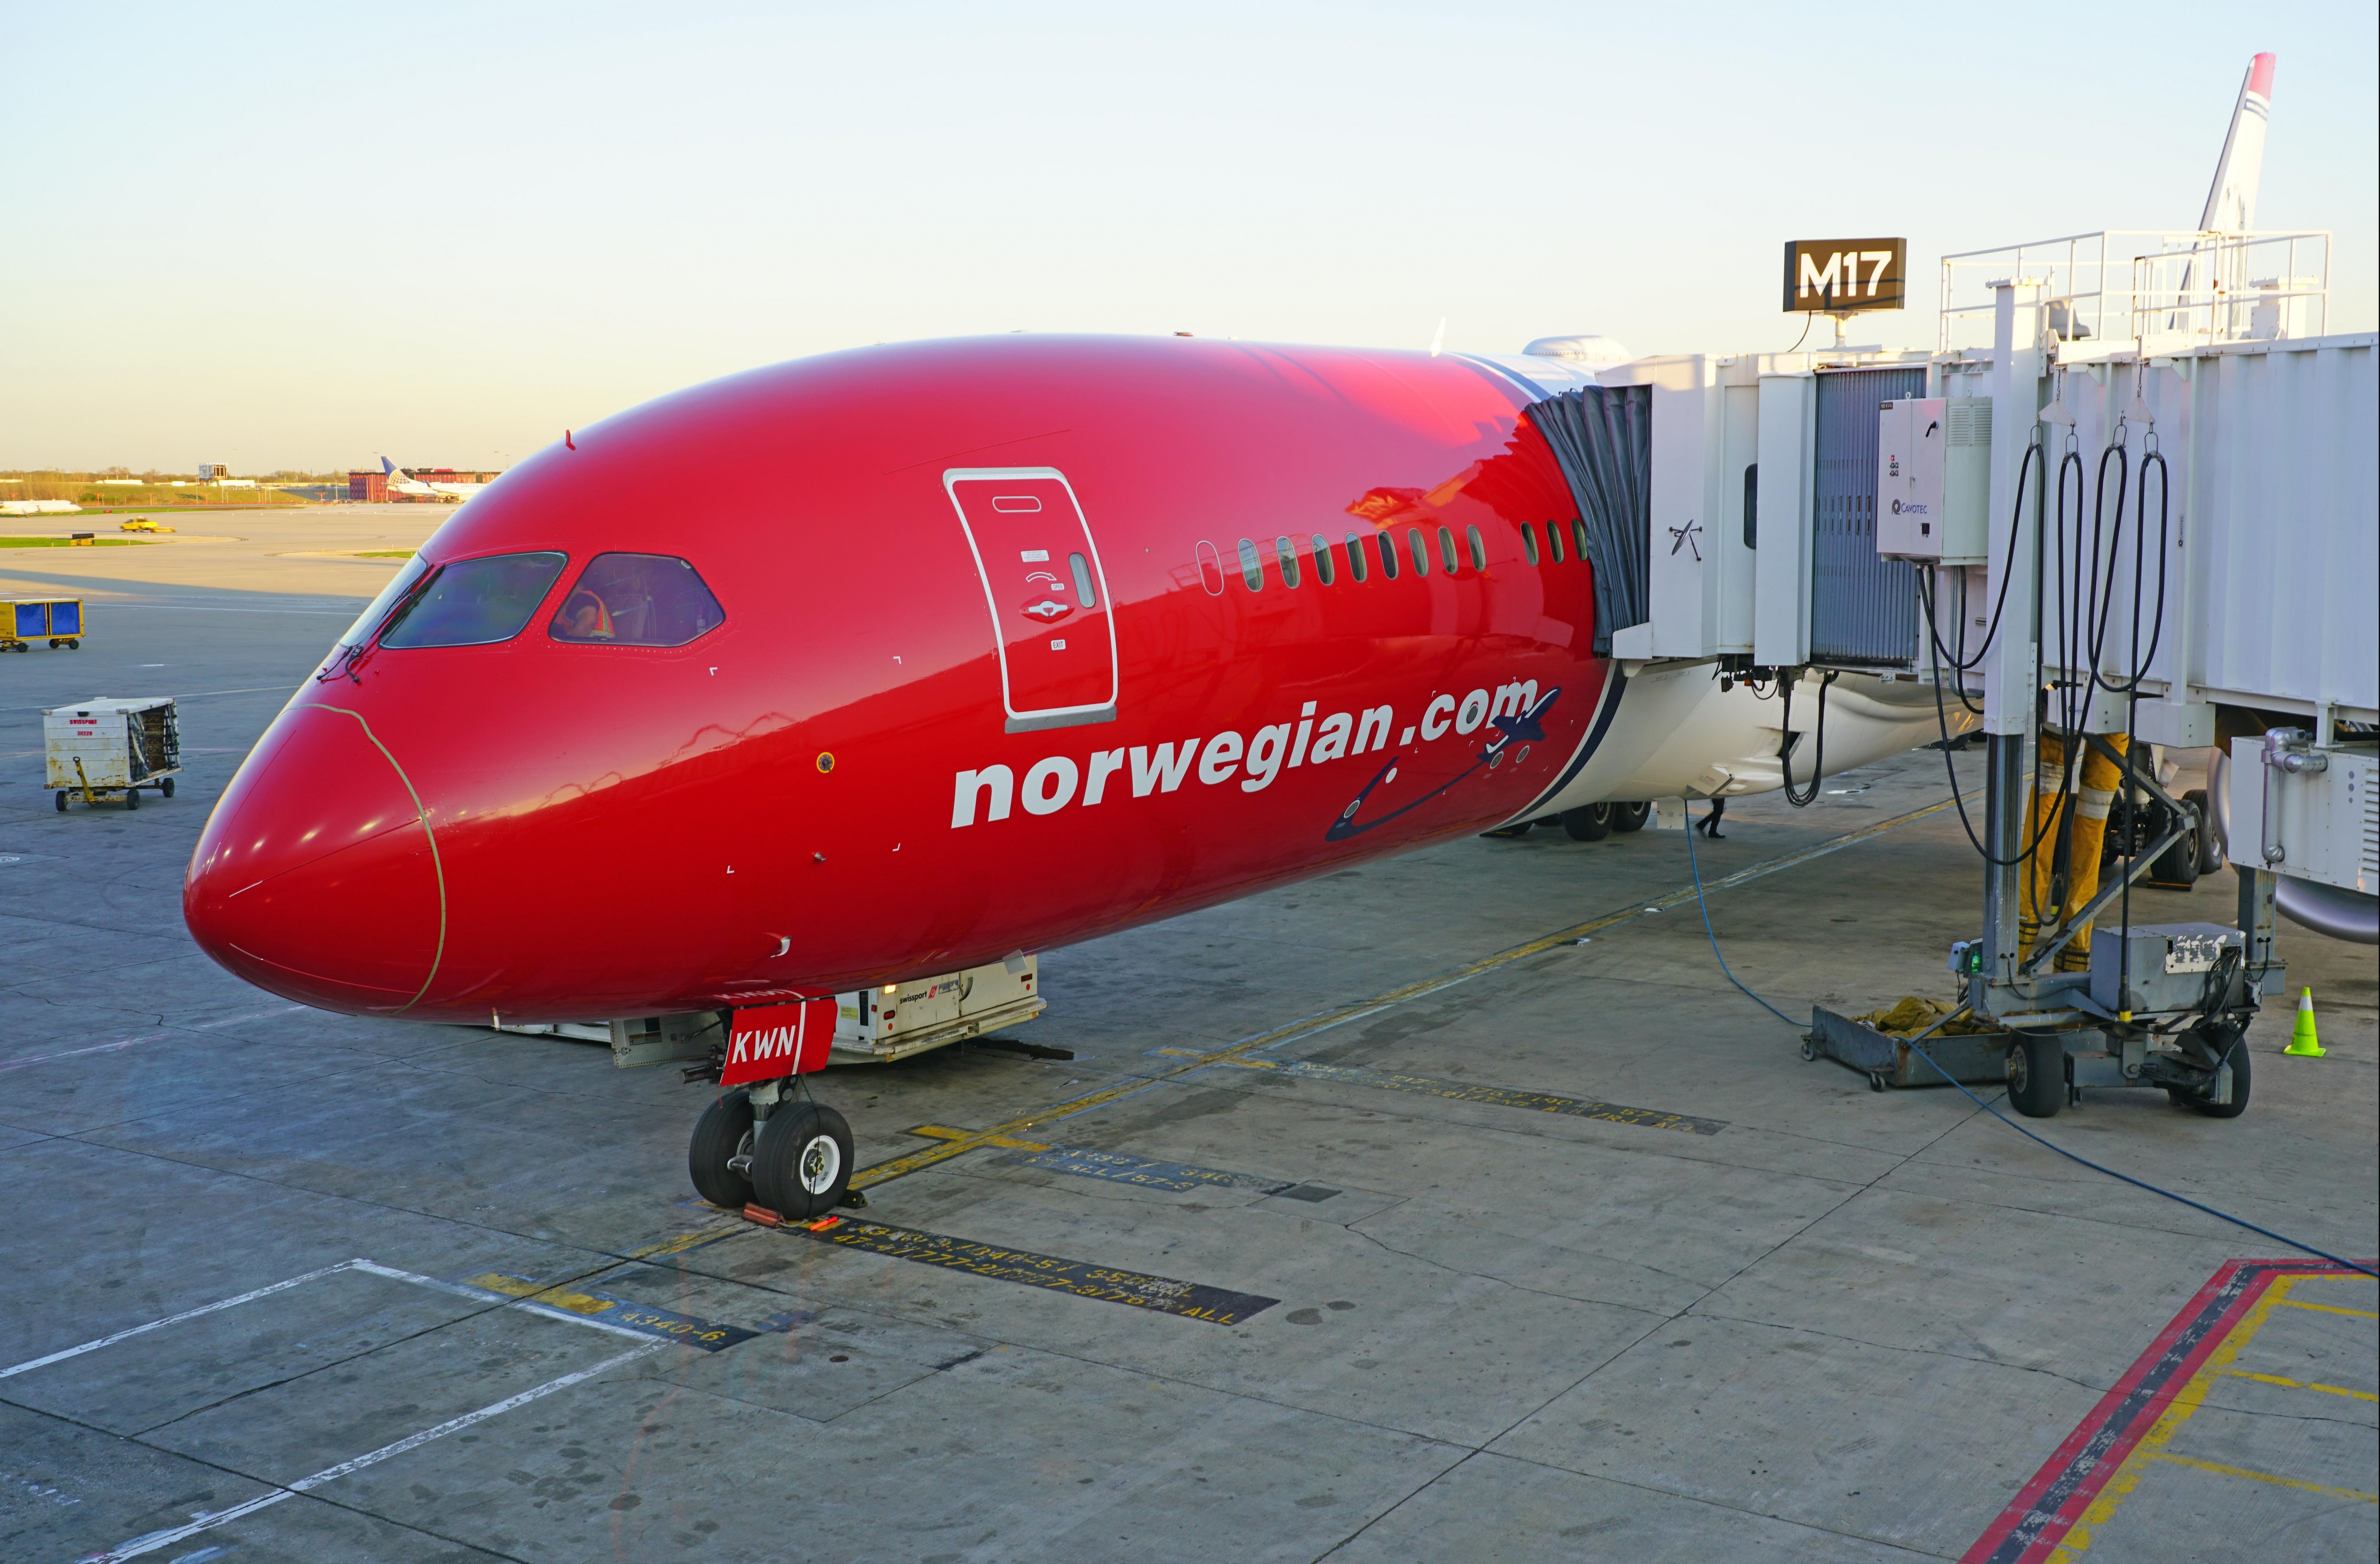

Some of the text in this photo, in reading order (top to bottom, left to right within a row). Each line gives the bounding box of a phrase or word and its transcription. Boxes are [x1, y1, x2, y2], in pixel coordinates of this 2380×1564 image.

[1799, 250, 1892, 298] M17
[1901, 503, 1927, 514] CAVOTEC
[1053, 641, 1063, 649] EXIT
[899, 990, 928, 1004] swissport
[732, 1025, 796, 1064] KWN
[1180, 1306, 1234, 1325] ALL
[621, 1312, 726, 1341] A340-6
